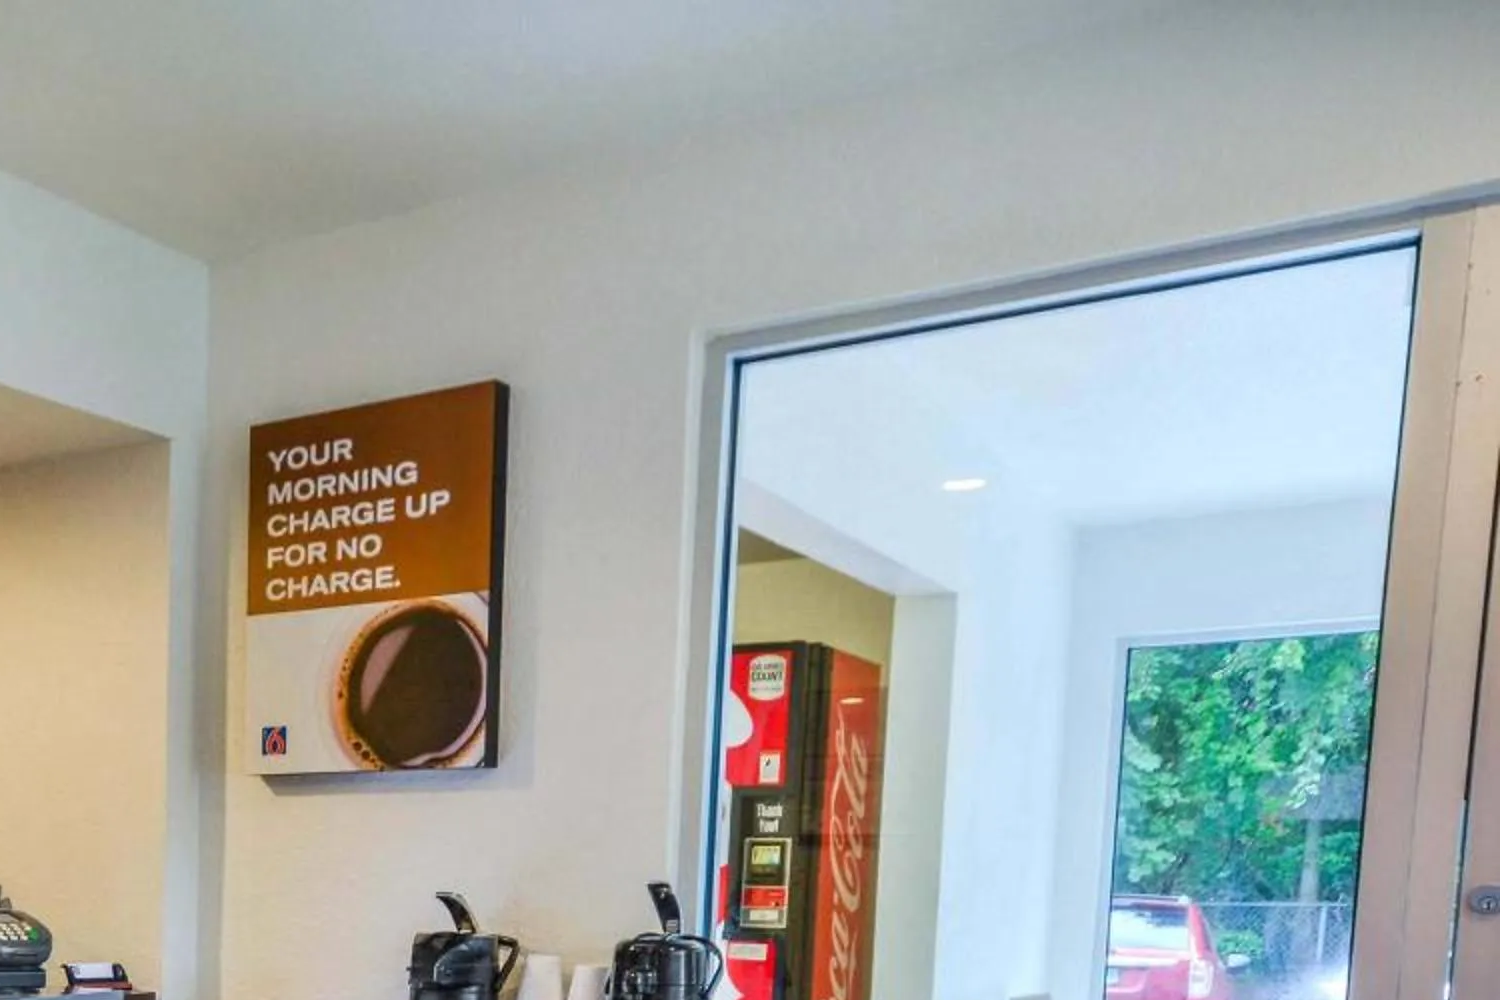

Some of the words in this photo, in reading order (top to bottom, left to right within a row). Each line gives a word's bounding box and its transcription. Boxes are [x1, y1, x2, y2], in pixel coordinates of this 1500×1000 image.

[267, 438, 354, 473] YOUR
[267, 461, 419, 505] MORNING
[266, 499, 396, 538] CHARGE
[405, 490, 451, 519] UP
[266, 544, 327, 569] FOR
[336, 534, 382, 559] NO
[266, 566, 402, 601] CHARGE.
